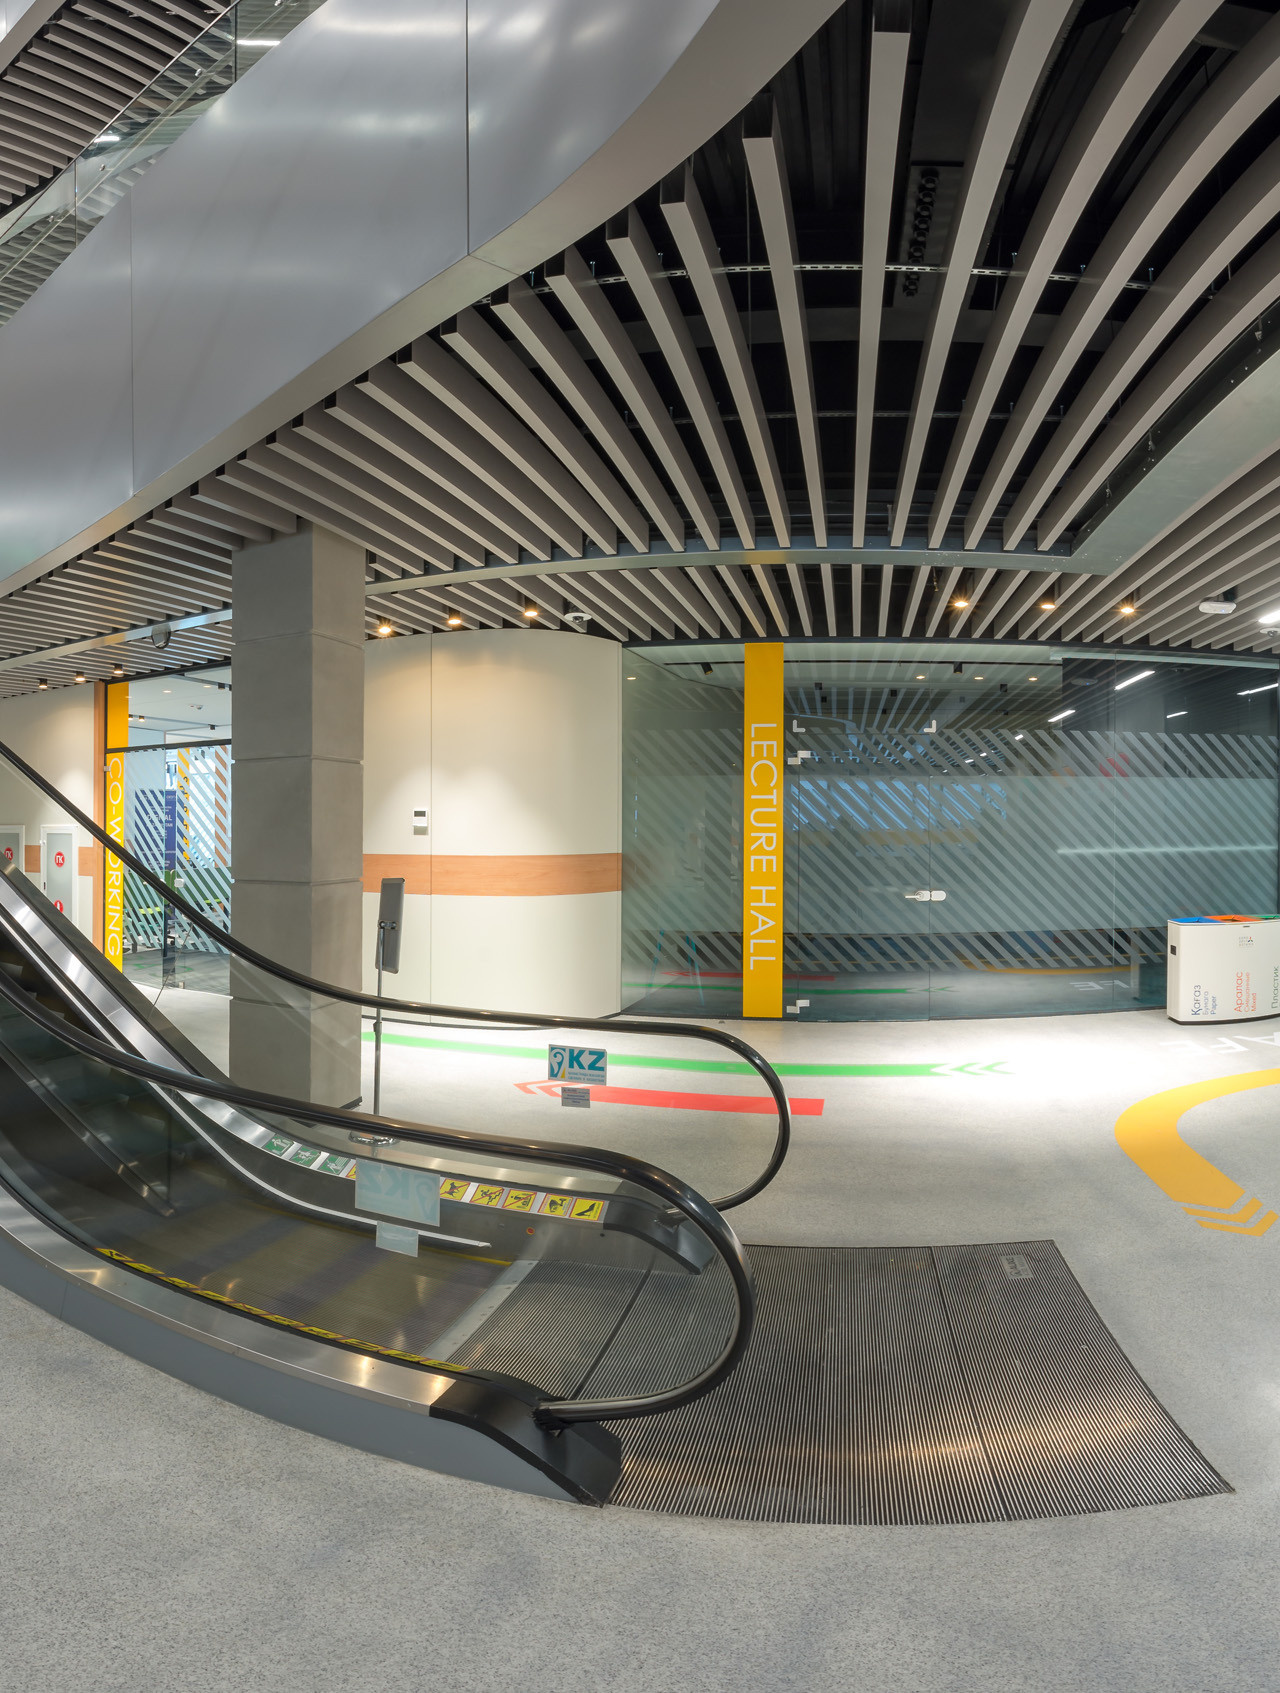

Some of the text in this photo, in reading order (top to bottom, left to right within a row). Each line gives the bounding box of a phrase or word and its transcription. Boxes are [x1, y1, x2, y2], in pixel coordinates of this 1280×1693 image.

[107, 757, 122, 956] CO-WORKING
[749, 723, 778, 971] LECTURE HALL
[1210, 995, 1218, 1015] Paper
[1234, 971, 1244, 1013] Аралас
[1271, 966, 1279, 1009] Пластик
[568, 1048, 606, 1072] KZ
